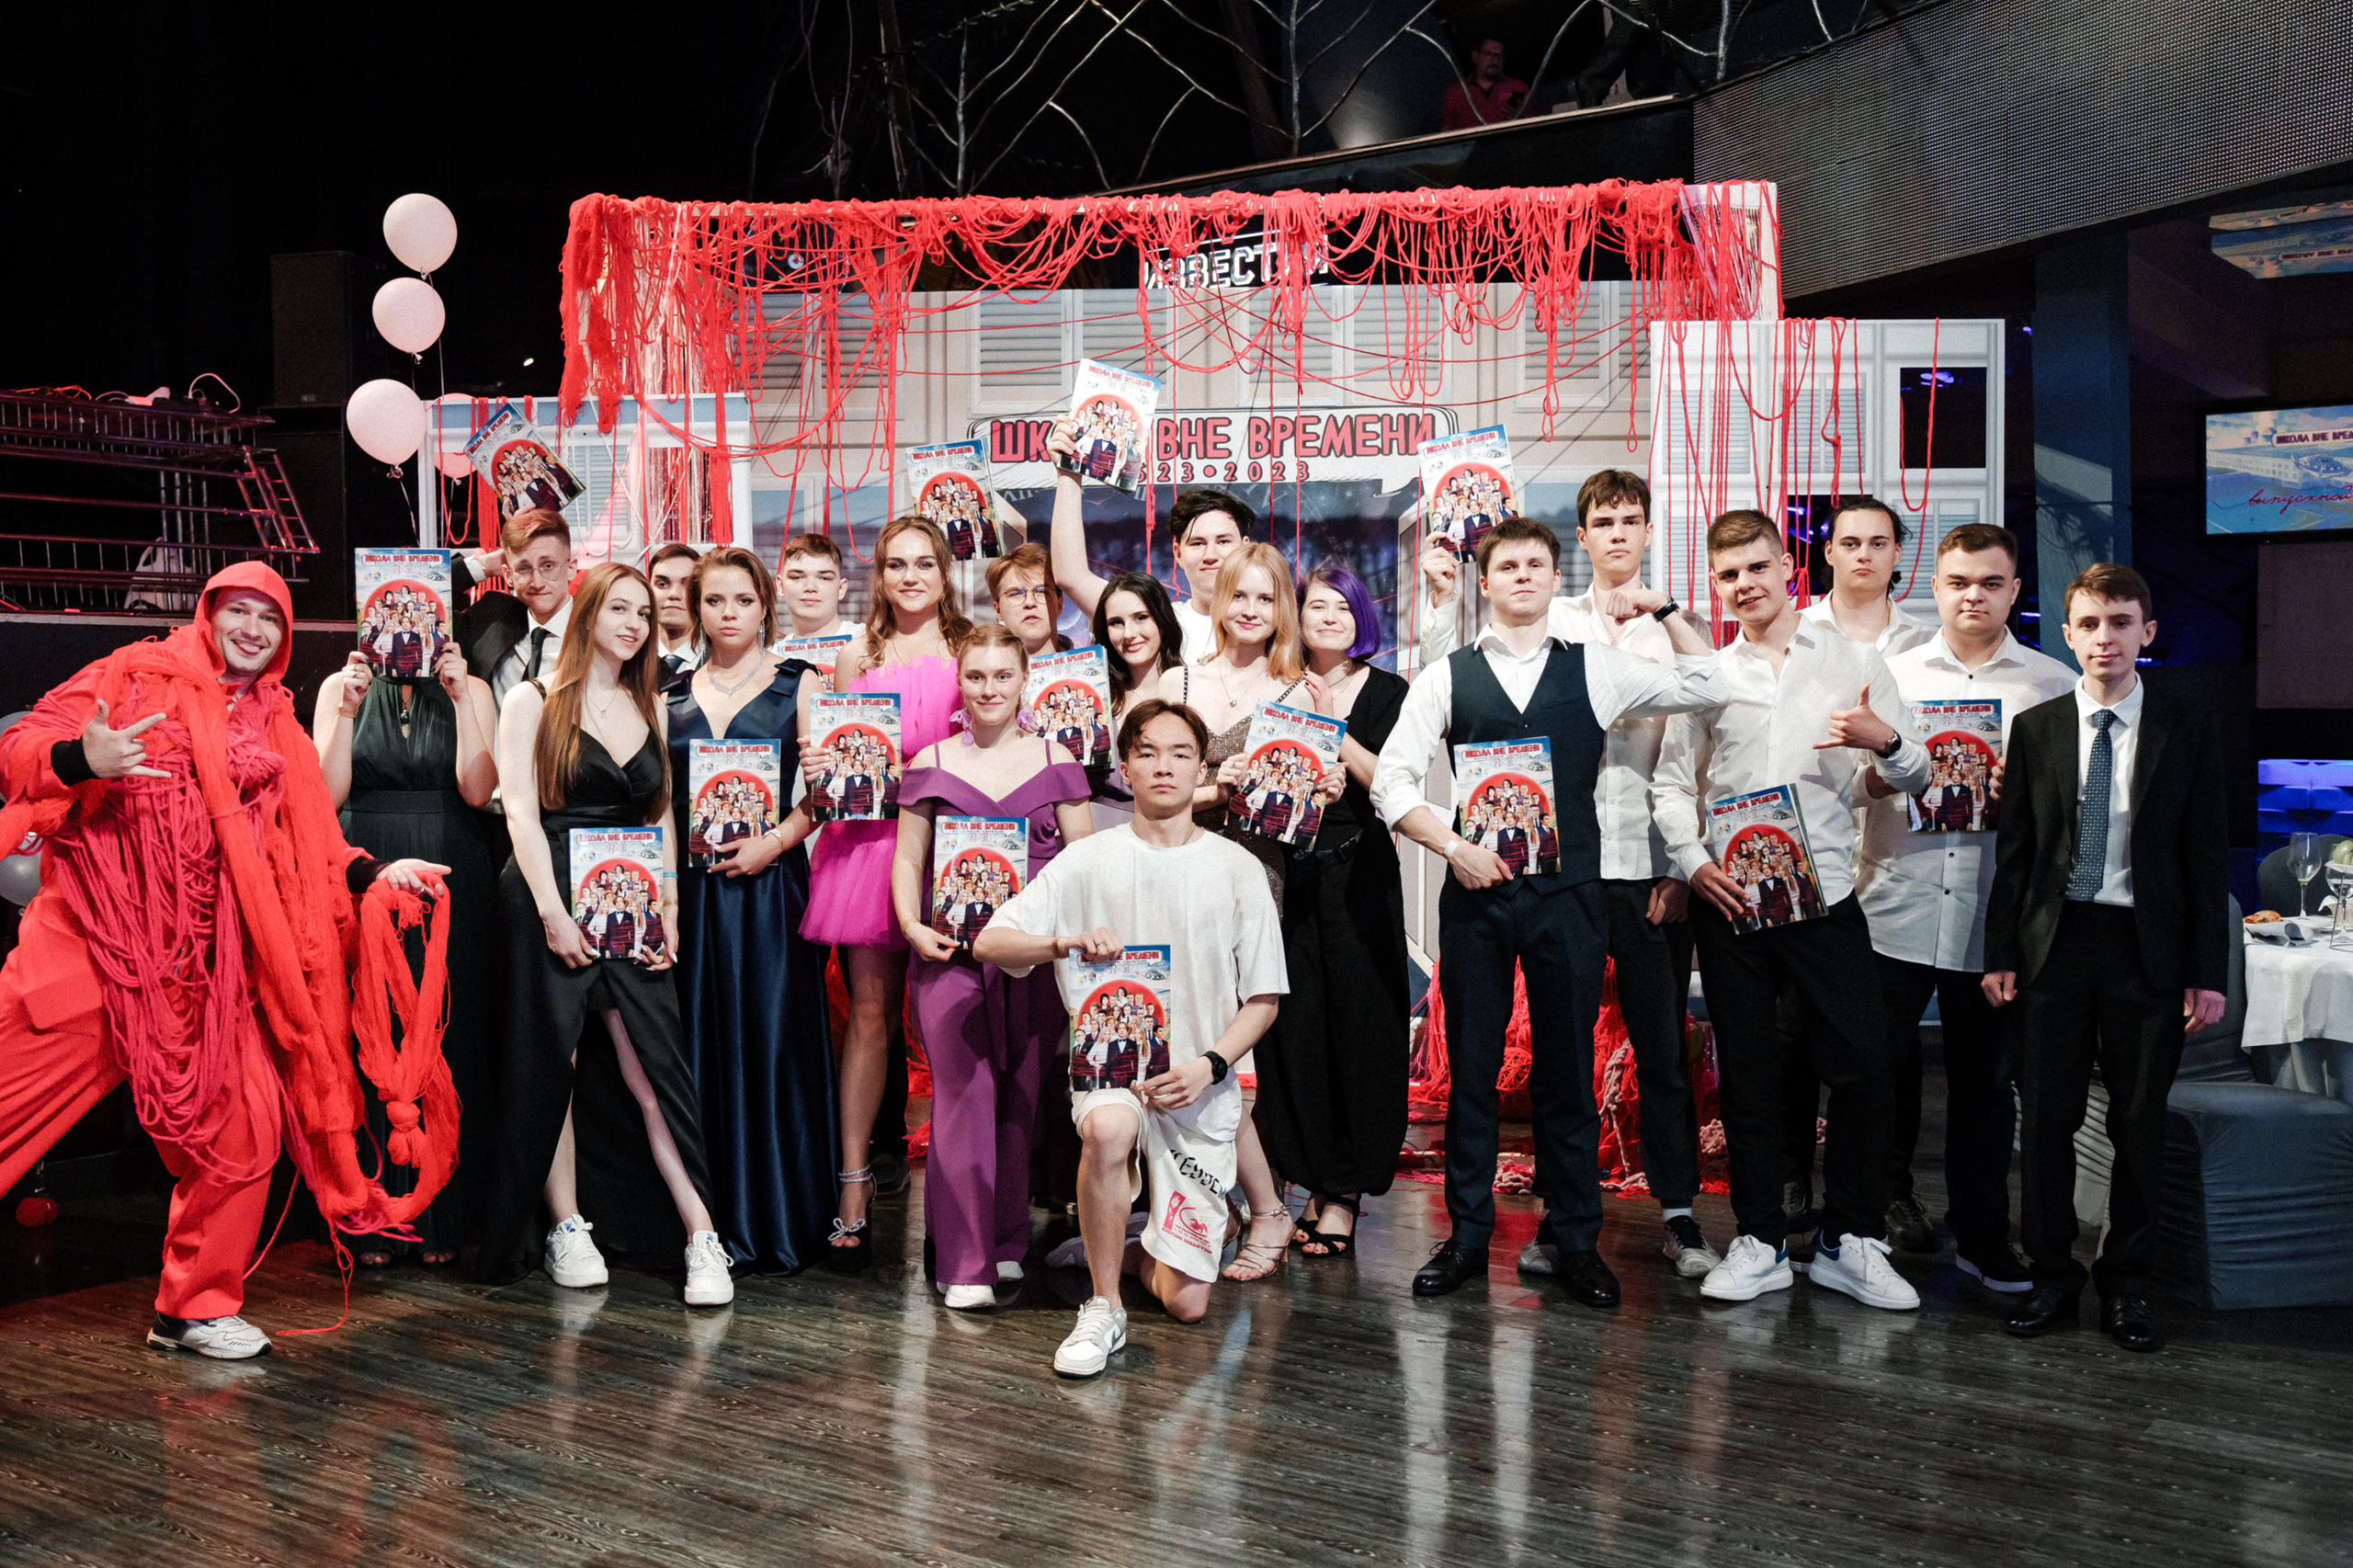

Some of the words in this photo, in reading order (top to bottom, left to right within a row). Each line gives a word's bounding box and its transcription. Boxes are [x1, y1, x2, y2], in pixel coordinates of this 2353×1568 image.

[1142, 234, 1329, 290] ИЗВЕСТЯ
[1156, 416, 1233, 461] ВНЕ
[1248, 413, 1436, 459] ВРЕМЕНИ
[2276, 434, 2310, 444] ШКОЛА
[2312, 432, 2329, 442] ВНЕ
[1125, 950, 1160, 960] ВРЕМЕНИ
